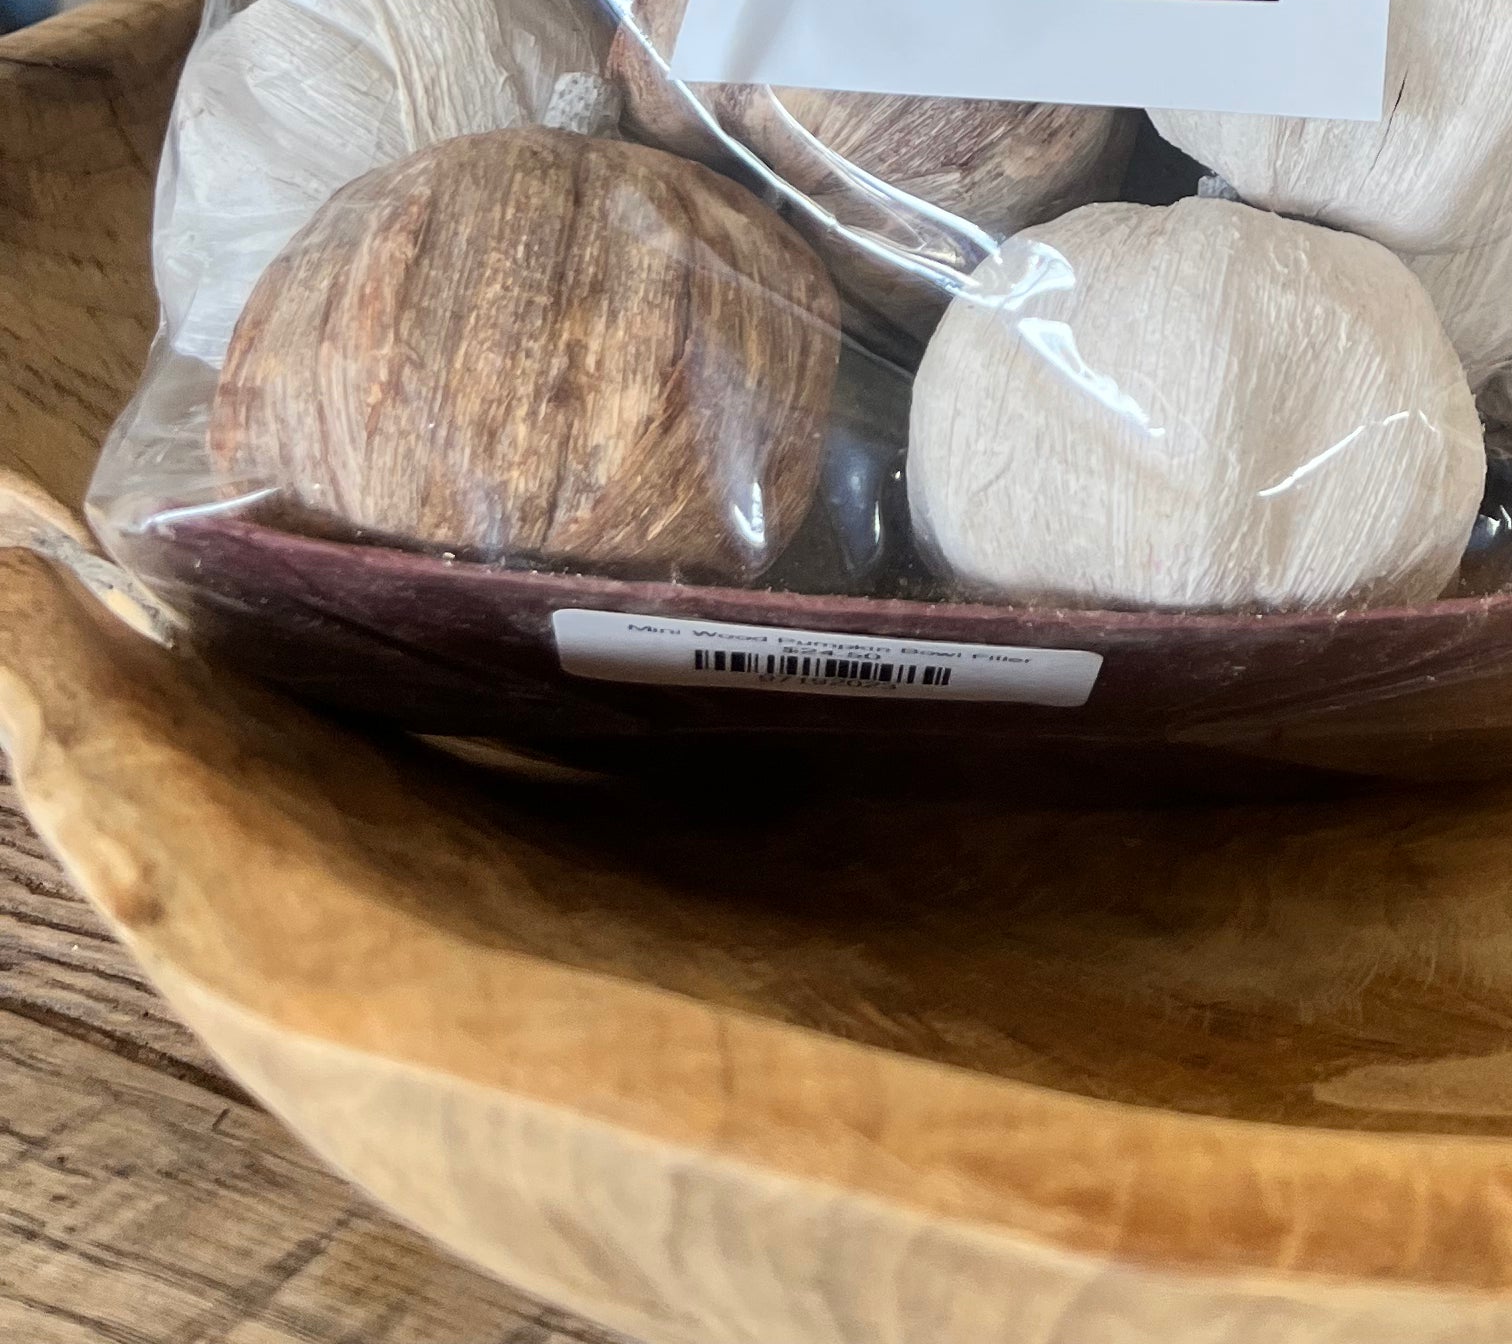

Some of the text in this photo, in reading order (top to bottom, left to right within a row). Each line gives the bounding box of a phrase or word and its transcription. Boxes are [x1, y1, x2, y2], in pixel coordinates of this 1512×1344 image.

[628, 624, 1031, 663] Mini Wood Pumpkin Bowl Filler
